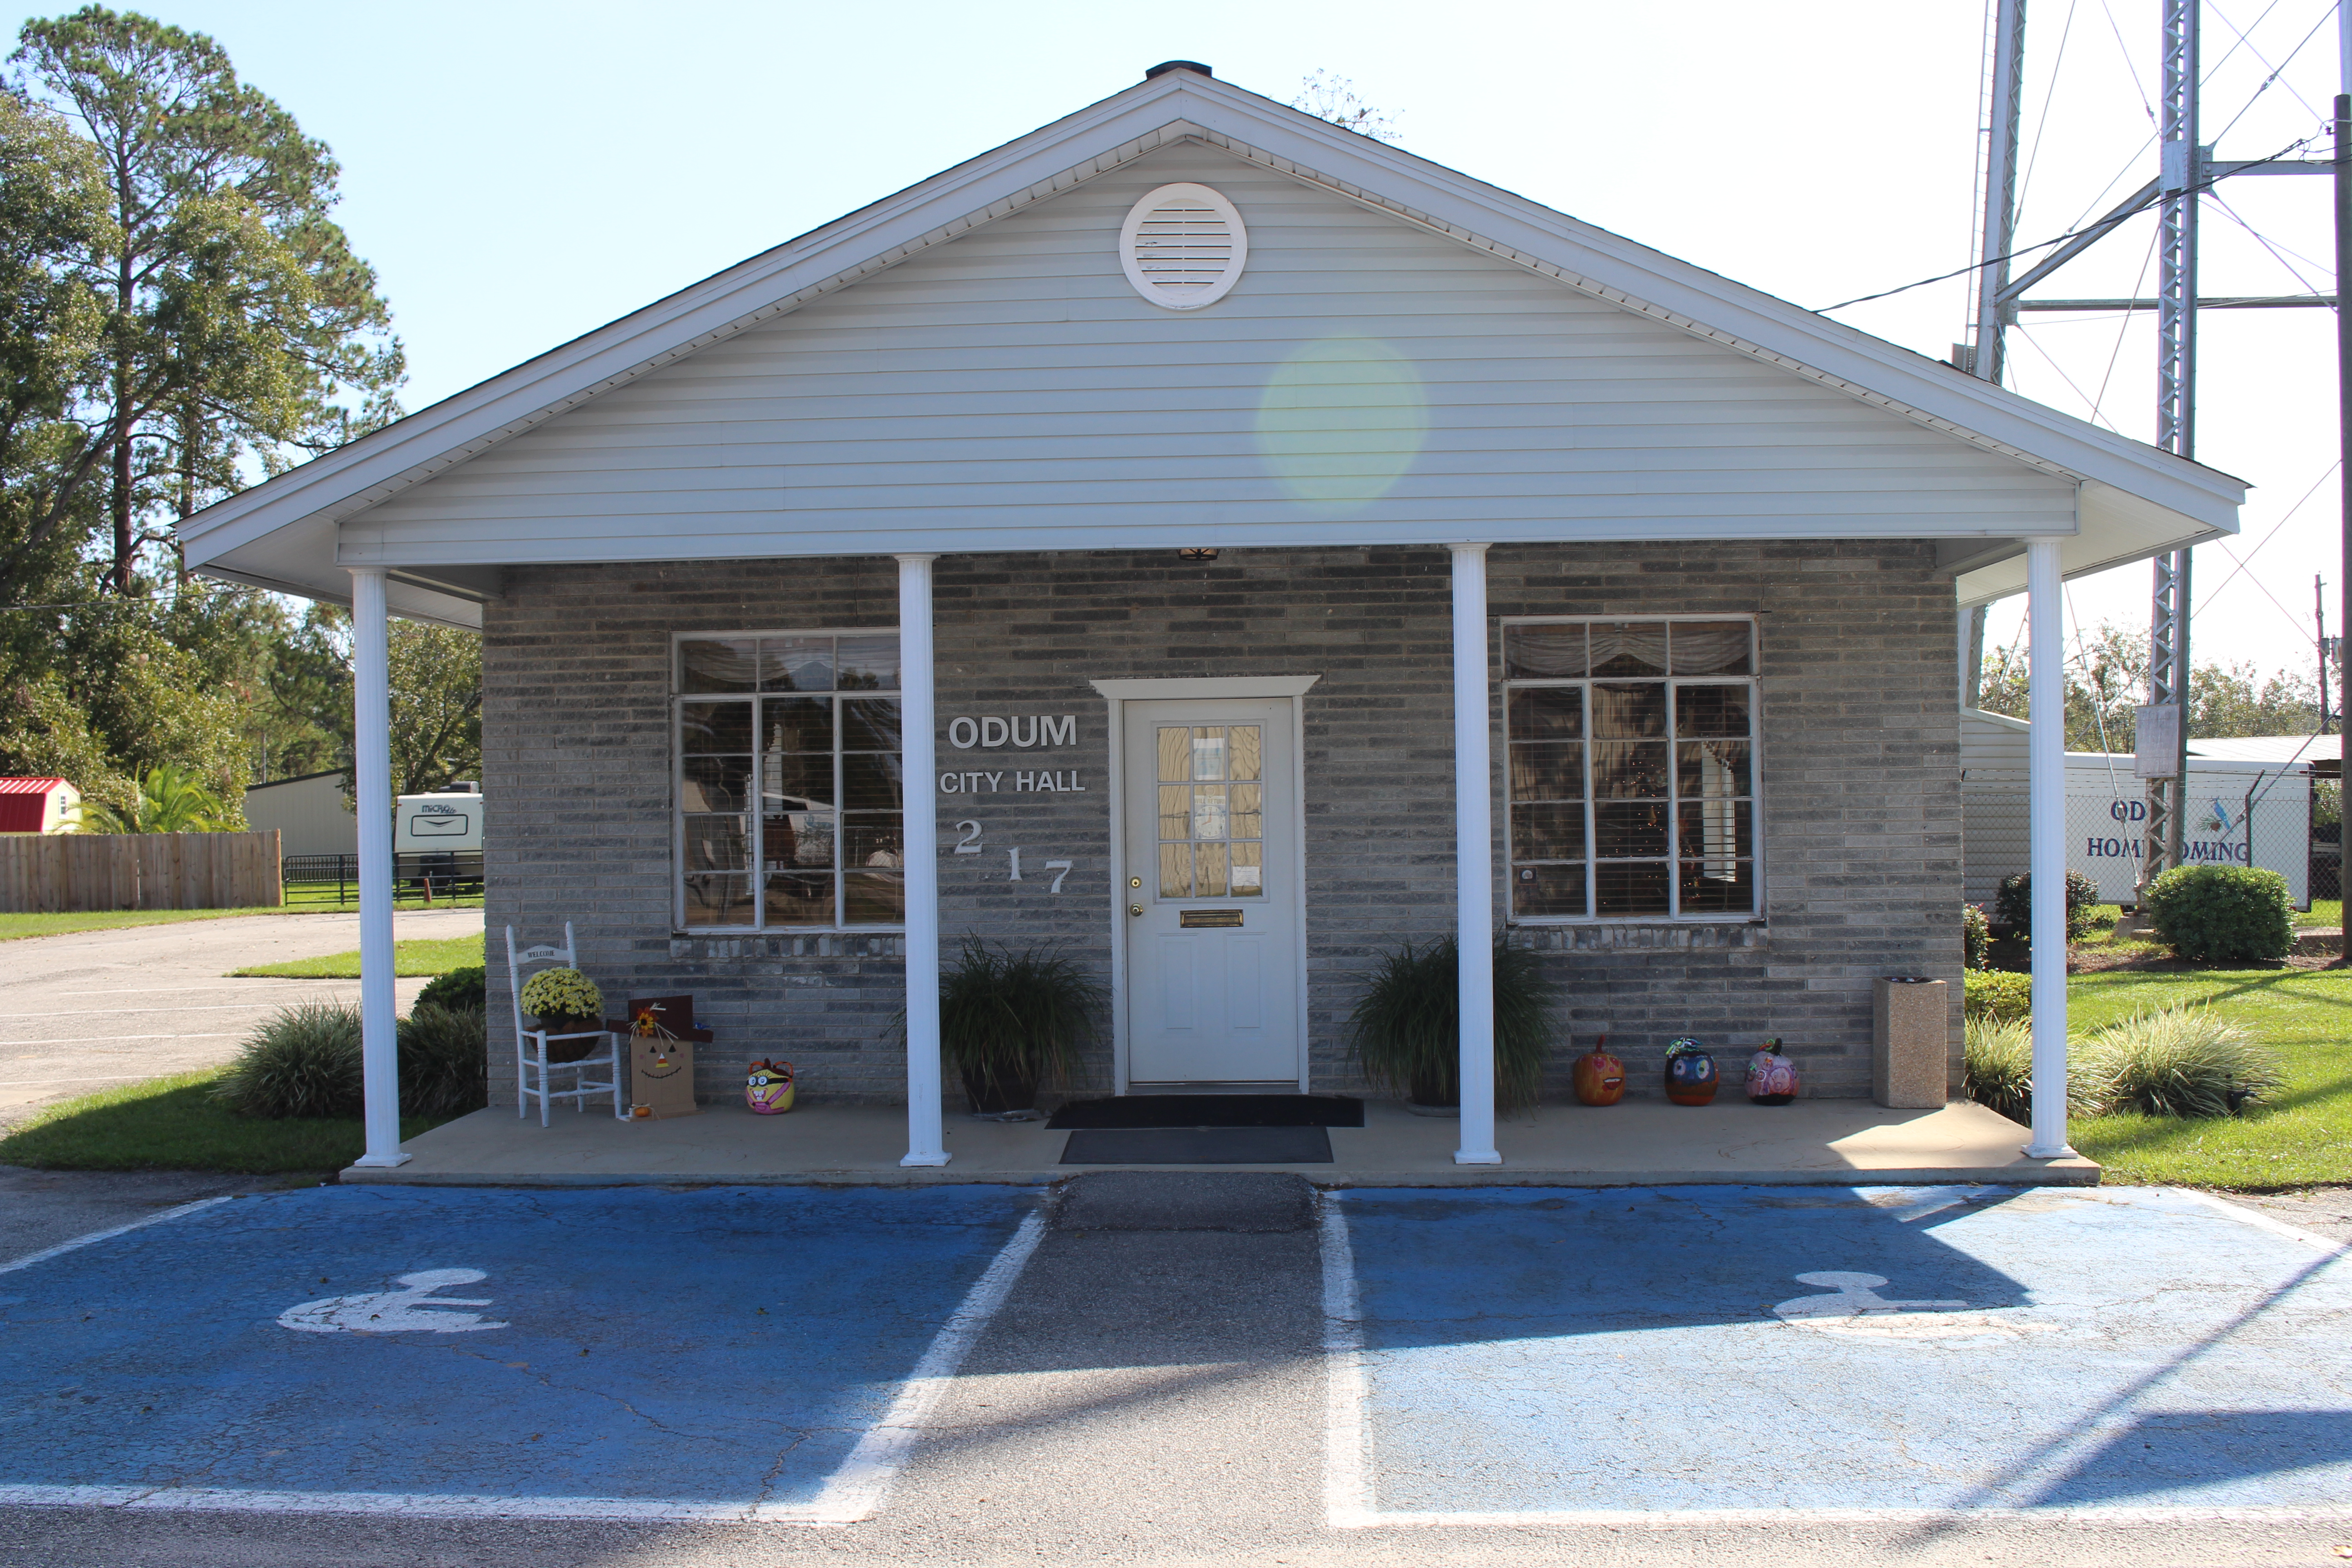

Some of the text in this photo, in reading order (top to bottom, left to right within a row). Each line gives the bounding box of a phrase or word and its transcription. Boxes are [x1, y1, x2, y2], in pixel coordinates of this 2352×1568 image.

[949, 715, 1076, 749] ODUM
[940, 770, 1086, 793] CITY HALL
